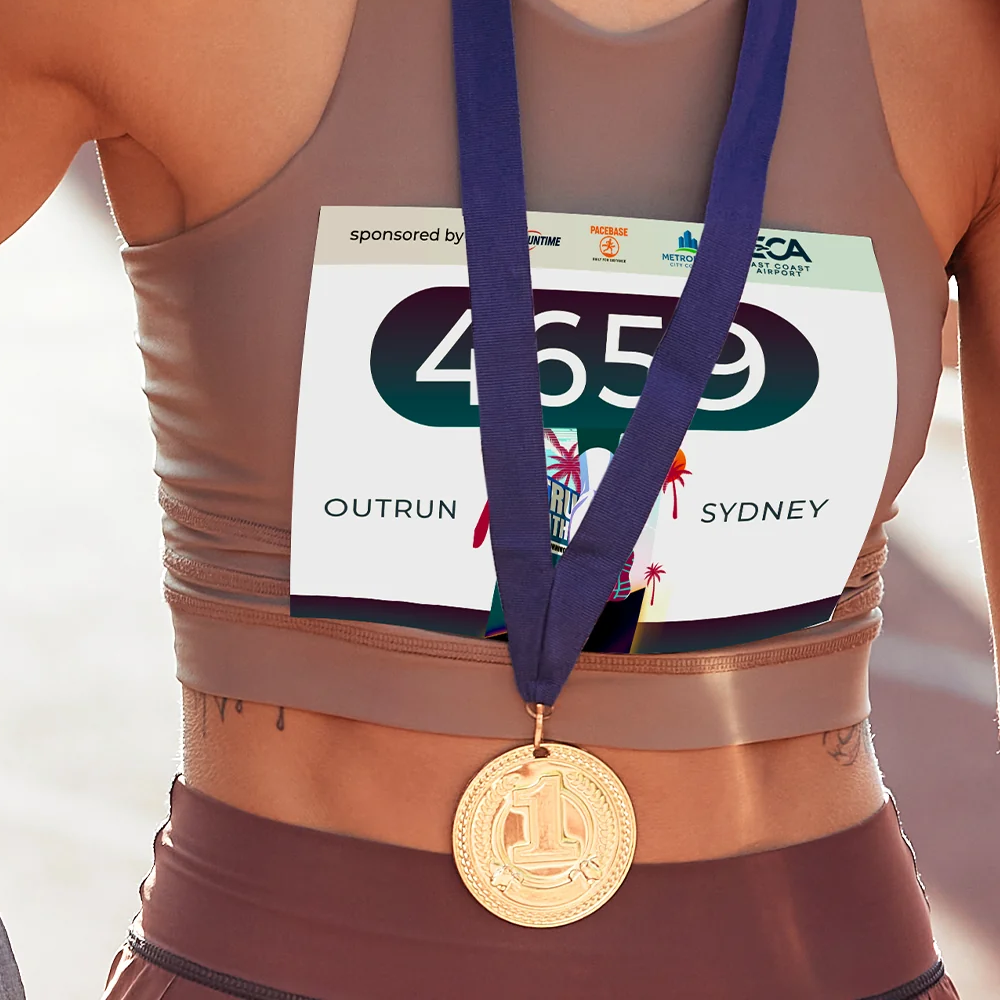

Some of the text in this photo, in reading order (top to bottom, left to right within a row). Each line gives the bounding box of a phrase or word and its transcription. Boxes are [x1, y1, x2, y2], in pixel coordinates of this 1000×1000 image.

[350, 228, 464, 245] sponsored by
[590, 225, 628, 237] PACEBASE
[528, 235, 561, 247] UNTIME
[662, 253, 697, 262] METRO
[757, 268, 801, 277] AIRPORT
[774, 263, 810, 272] COAST
[416, 309, 766, 412] 4659
[324, 498, 457, 519] OUTRUN
[700, 499, 830, 523] SYDNEY
